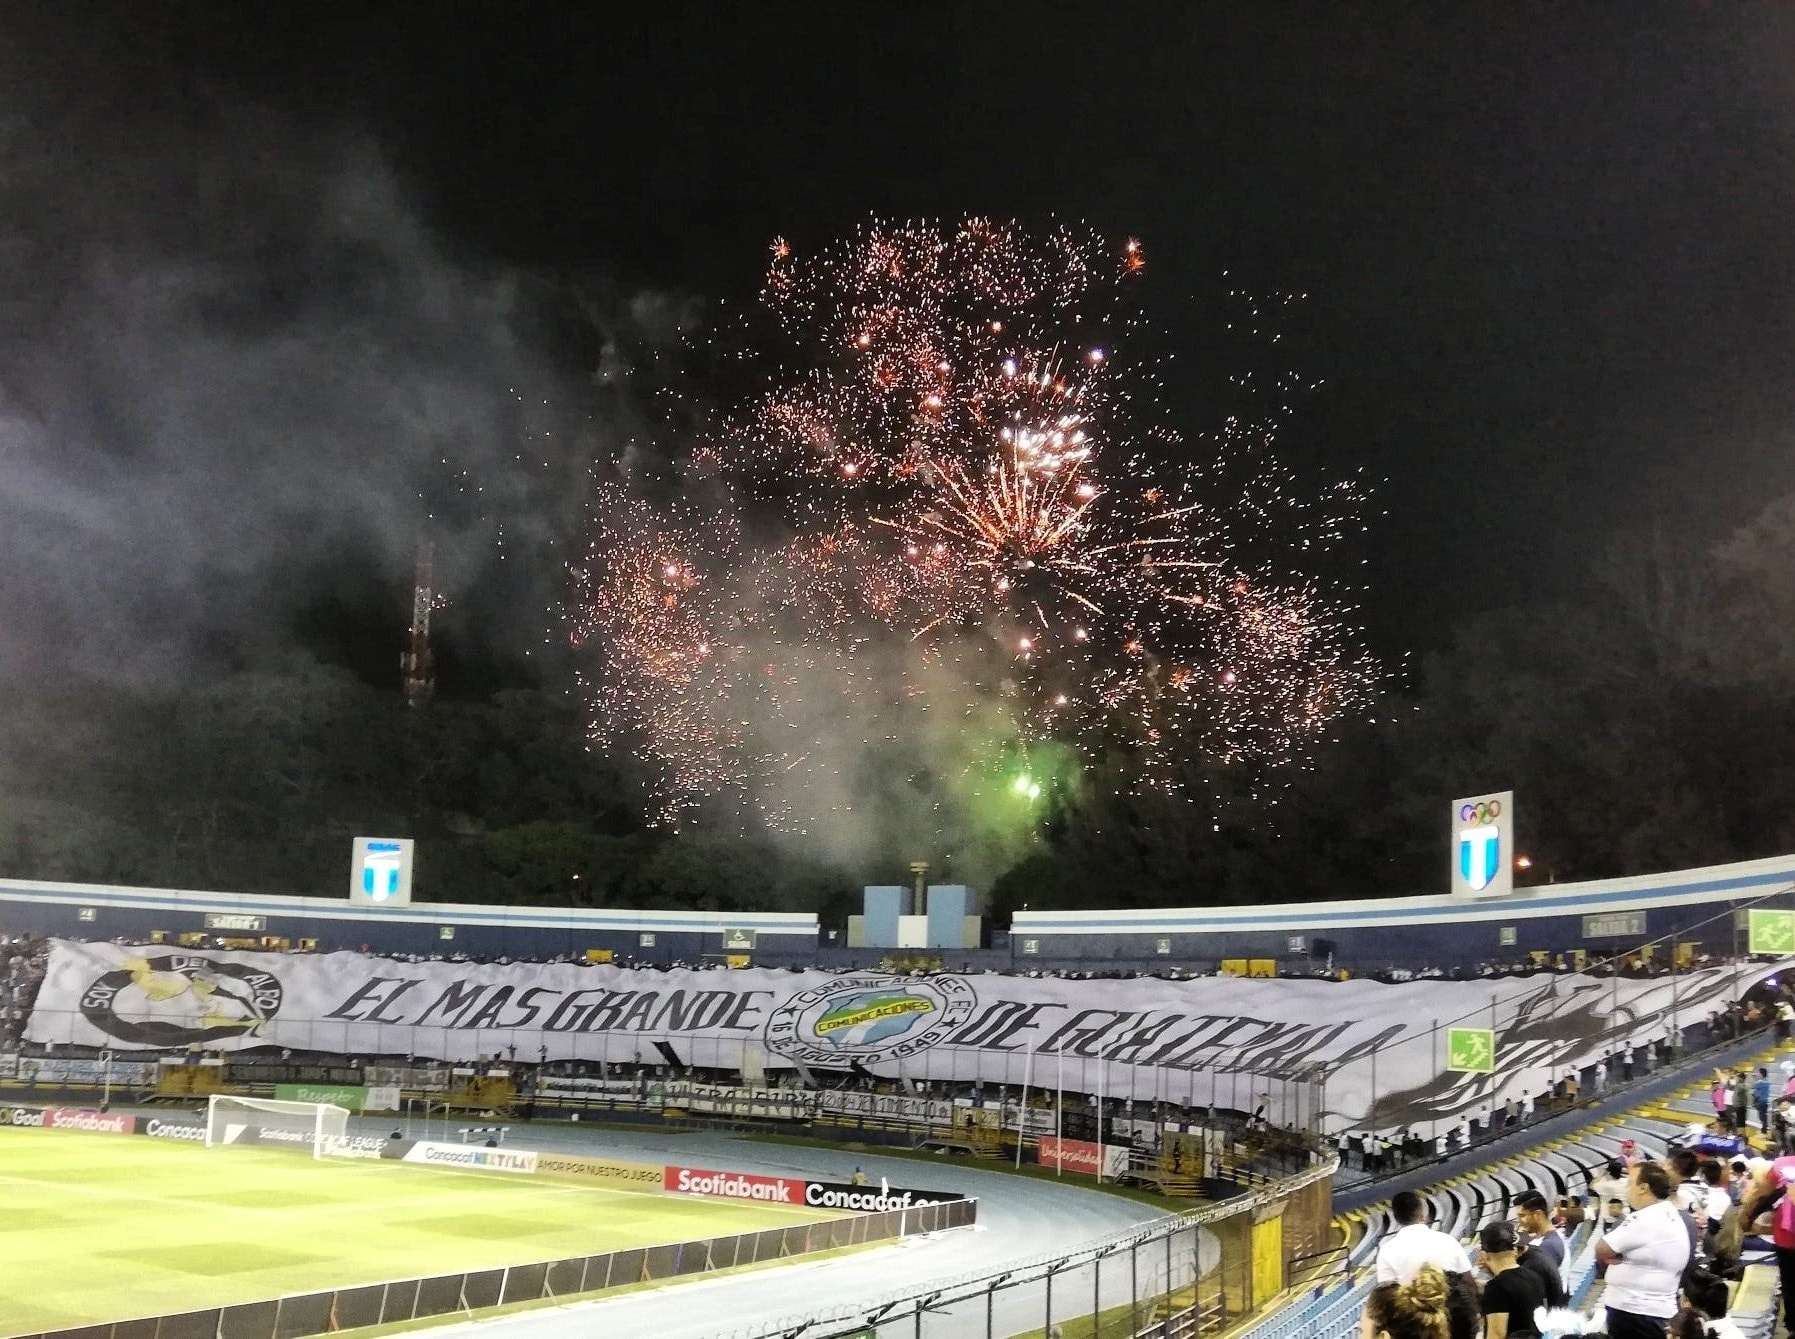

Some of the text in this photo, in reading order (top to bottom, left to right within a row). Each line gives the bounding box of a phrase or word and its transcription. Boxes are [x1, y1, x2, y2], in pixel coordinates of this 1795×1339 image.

[322, 976, 776, 1032] EL MAS GRANDE
[818, 1001, 930, 1032] COMUNICACIONES
[945, 1000, 1068, 1051] DE
[891, 1031, 941, 1058] 1949
[52, 1111, 125, 1133] Scotiabank
[146, 1120, 208, 1140] Concaca
[425, 1147, 474, 1163] Concacaf
[587, 1165, 629, 1179] NUESTRO
[630, 1170, 662, 1183] JUEGO
[677, 1169, 790, 1202] Scotiabank
